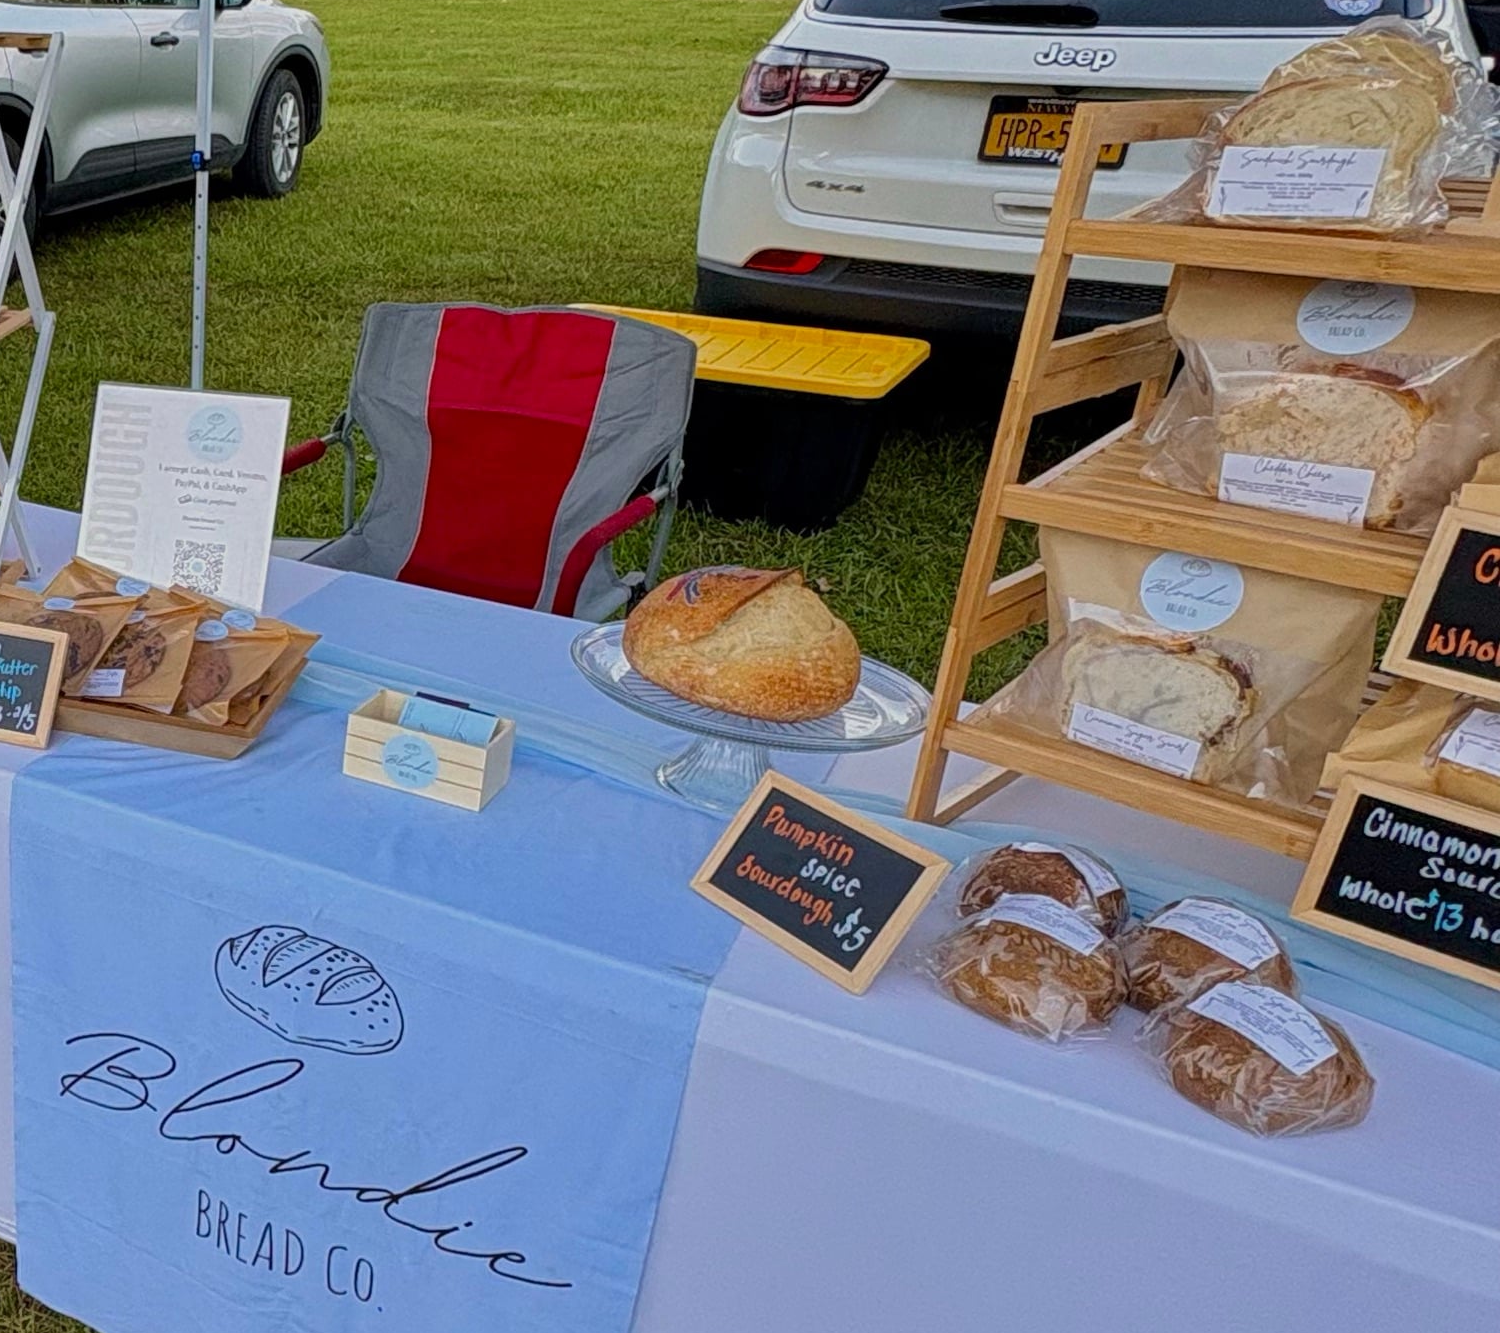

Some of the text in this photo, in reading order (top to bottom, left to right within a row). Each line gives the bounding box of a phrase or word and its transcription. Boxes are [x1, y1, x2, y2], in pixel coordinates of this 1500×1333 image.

[1033, 41, 1117, 72] Jeep
[997, 118, 1042, 149] HPR
[1007, 146, 1065, 165] WESTH
[1303, 299, 1403, 322] Blondie
[1145, 578, 1232, 606] Blondie
[763, 804, 854, 866] Pumpkin
[1363, 807, 1500, 870] Cinnamon
[736, 854, 871, 952] Sourdough $5
[1428, 888, 1464, 931] $13
[60, 1033, 572, 1288] Blondie
[196, 1189, 384, 1312] BREAD CO.
